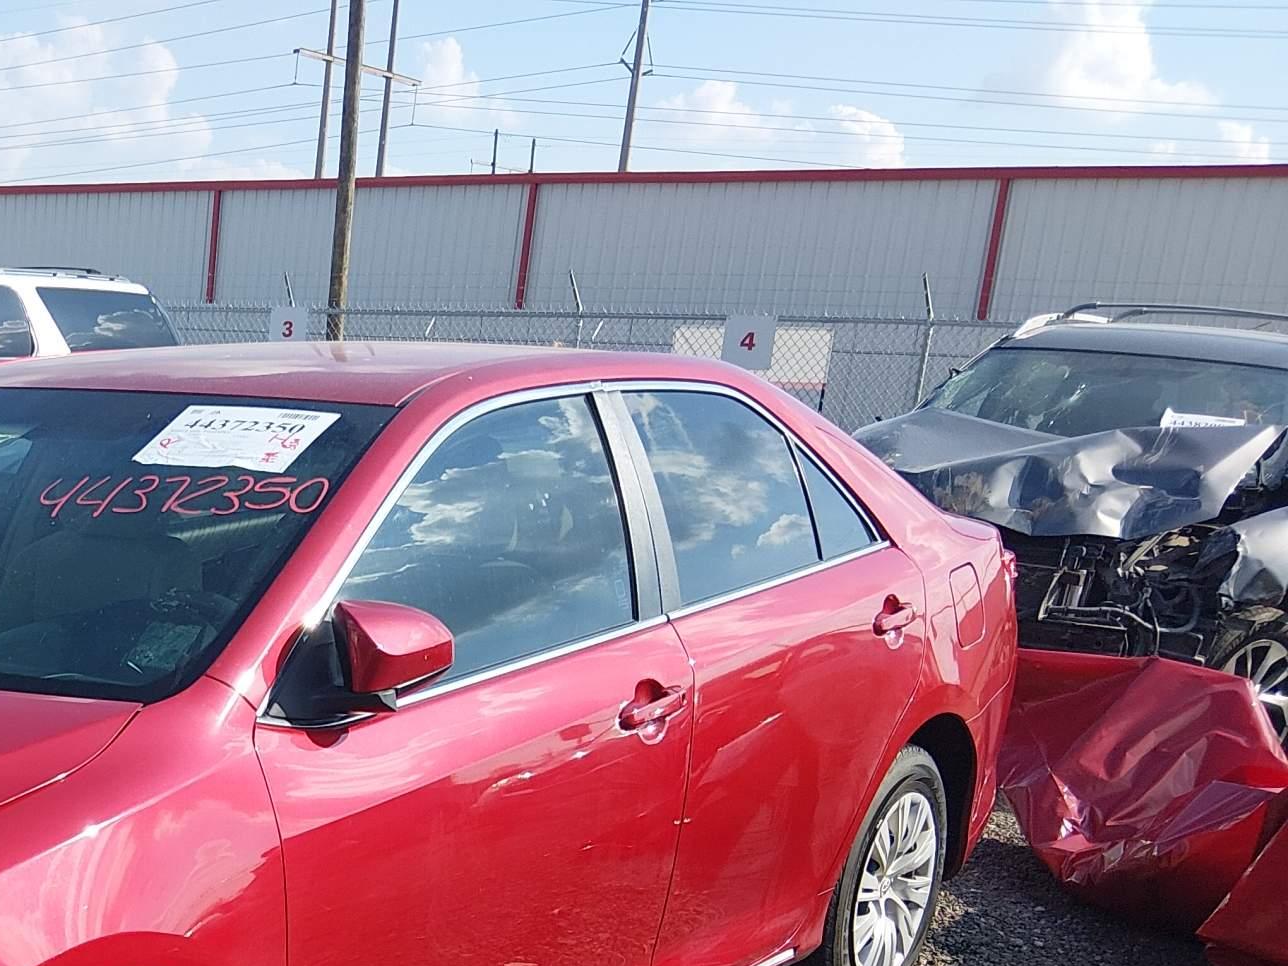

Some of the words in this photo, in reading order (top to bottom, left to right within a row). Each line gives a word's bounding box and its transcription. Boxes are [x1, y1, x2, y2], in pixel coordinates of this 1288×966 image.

[282, 321, 293, 337] 3
[740, 332, 755, 350] 4
[185, 418, 305, 433] 44372350
[40, 475, 330, 517] 44372350
